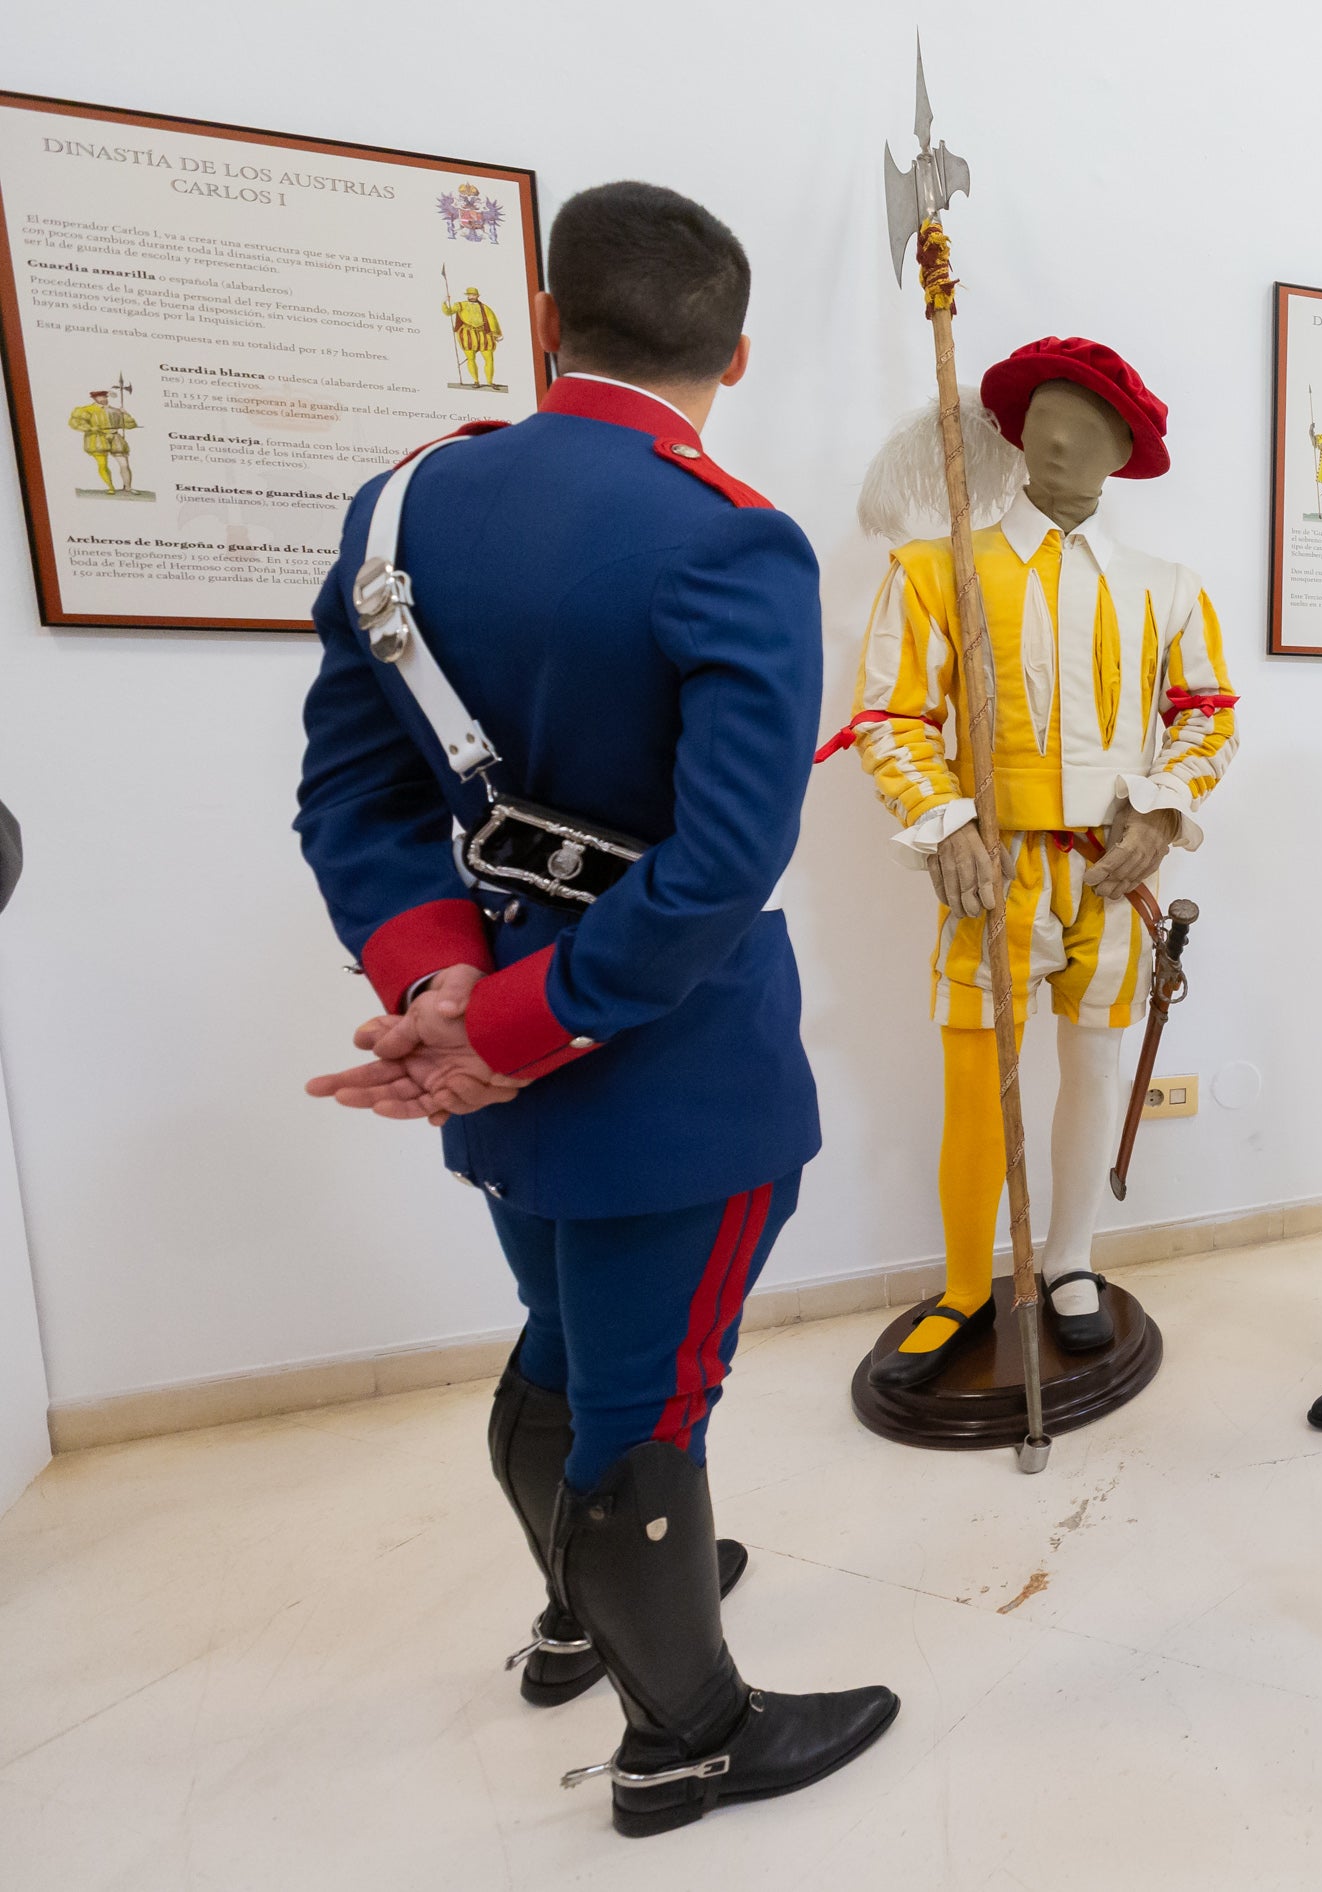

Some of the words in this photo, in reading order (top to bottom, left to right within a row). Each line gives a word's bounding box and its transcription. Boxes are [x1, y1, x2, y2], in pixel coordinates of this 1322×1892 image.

[43, 137, 172, 168] DINASTÍA
[179, 157, 216, 174] DE
[223, 163, 272, 182] LOS
[279, 172, 395, 199] AUSTRIAS
[170, 178, 271, 204] CARLOS
[277, 192, 286, 206] I
[26, 214, 39, 223] El
[42, 218, 109, 232] emperador
[111, 225, 150, 236] Carlos
[188, 236, 217, 245] crear
[220, 239, 241, 248] una
[244, 243, 300, 255] estructura
[302, 250, 322, 258] que
[361, 257, 412, 268] mantener
[27, 259, 88, 272] Guardia
[92, 268, 156, 280] amarilla
[168, 277, 218, 287] española
[221, 280, 293, 296] (alabarderos)
[30, 275, 104, 290] Procedentes
[106, 282, 120, 292] de
[123, 284, 134, 293] la
[137, 288, 180, 298] guardia
[183, 293, 231, 304] personal
[234, 296, 251, 306] del
[255, 301, 272, 310] rey
[275, 301, 329, 315] Fernando,
[332, 309, 366, 318] mozos
[368, 310, 412, 324] hidalgos
[32, 296, 69, 308] hayan
[72, 301, 97, 311] sido
[100, 306, 160, 317] castigados
[162, 312, 183, 320] por
[185, 312, 195, 321] la
[36, 319, 61, 329] Esta
[64, 324, 109, 334] guardia
[111, 328, 148, 338] estaba
[150, 333, 212, 344] compuesta
[247, 341, 295, 352] totalidad
[341, 348, 389, 360] hombres.
[159, 363, 217, 375] Guardia
[219, 367, 265, 380] blanca
[278, 374, 318, 384] tudesca
[321, 378, 384, 389] (alabarderos
[387, 383, 419, 393] alema-
[160, 375, 184, 384] nes)
[163, 389, 179, 398] En
[226, 396, 287, 407] incorporan
[297, 399, 307, 408] la
[310, 402, 349, 412] guardia
[351, 405, 371, 414] real
[373, 406, 389, 415] del
[391, 410, 447, 420] emperador
[164, 399, 228, 412] alabarderos
[230, 405, 278, 416] tudescos
[167, 431, 225, 442] Guardia
[266, 439, 310, 448] formada
[335, 442, 350, 451] los
[353, 445, 399, 454] inválidos
[169, 443, 193, 451] para
[196, 442, 206, 452] la
[208, 446, 254, 455] custodia
[257, 447, 270, 456] de
[273, 448, 288, 457] los
[291, 450, 334, 460] infantes
[336, 452, 349, 462] de
[351, 454, 390, 464] Castilla
[204, 454, 237, 464] (unos
[240, 458, 252, 466] 25
[175, 483, 253, 495] Estradiotes
[266, 490, 323, 499] guardias
[324, 491, 340, 500] de
[342, 492, 353, 502] la
[175, 493, 216, 503] (jinetes
[67, 535, 131, 545] Archeros
[134, 537, 151, 546] de
[154, 539, 214, 550] Borgoña
[228, 543, 280, 552] guardia
[283, 544, 299, 553] de
[301, 545, 314, 553] la
